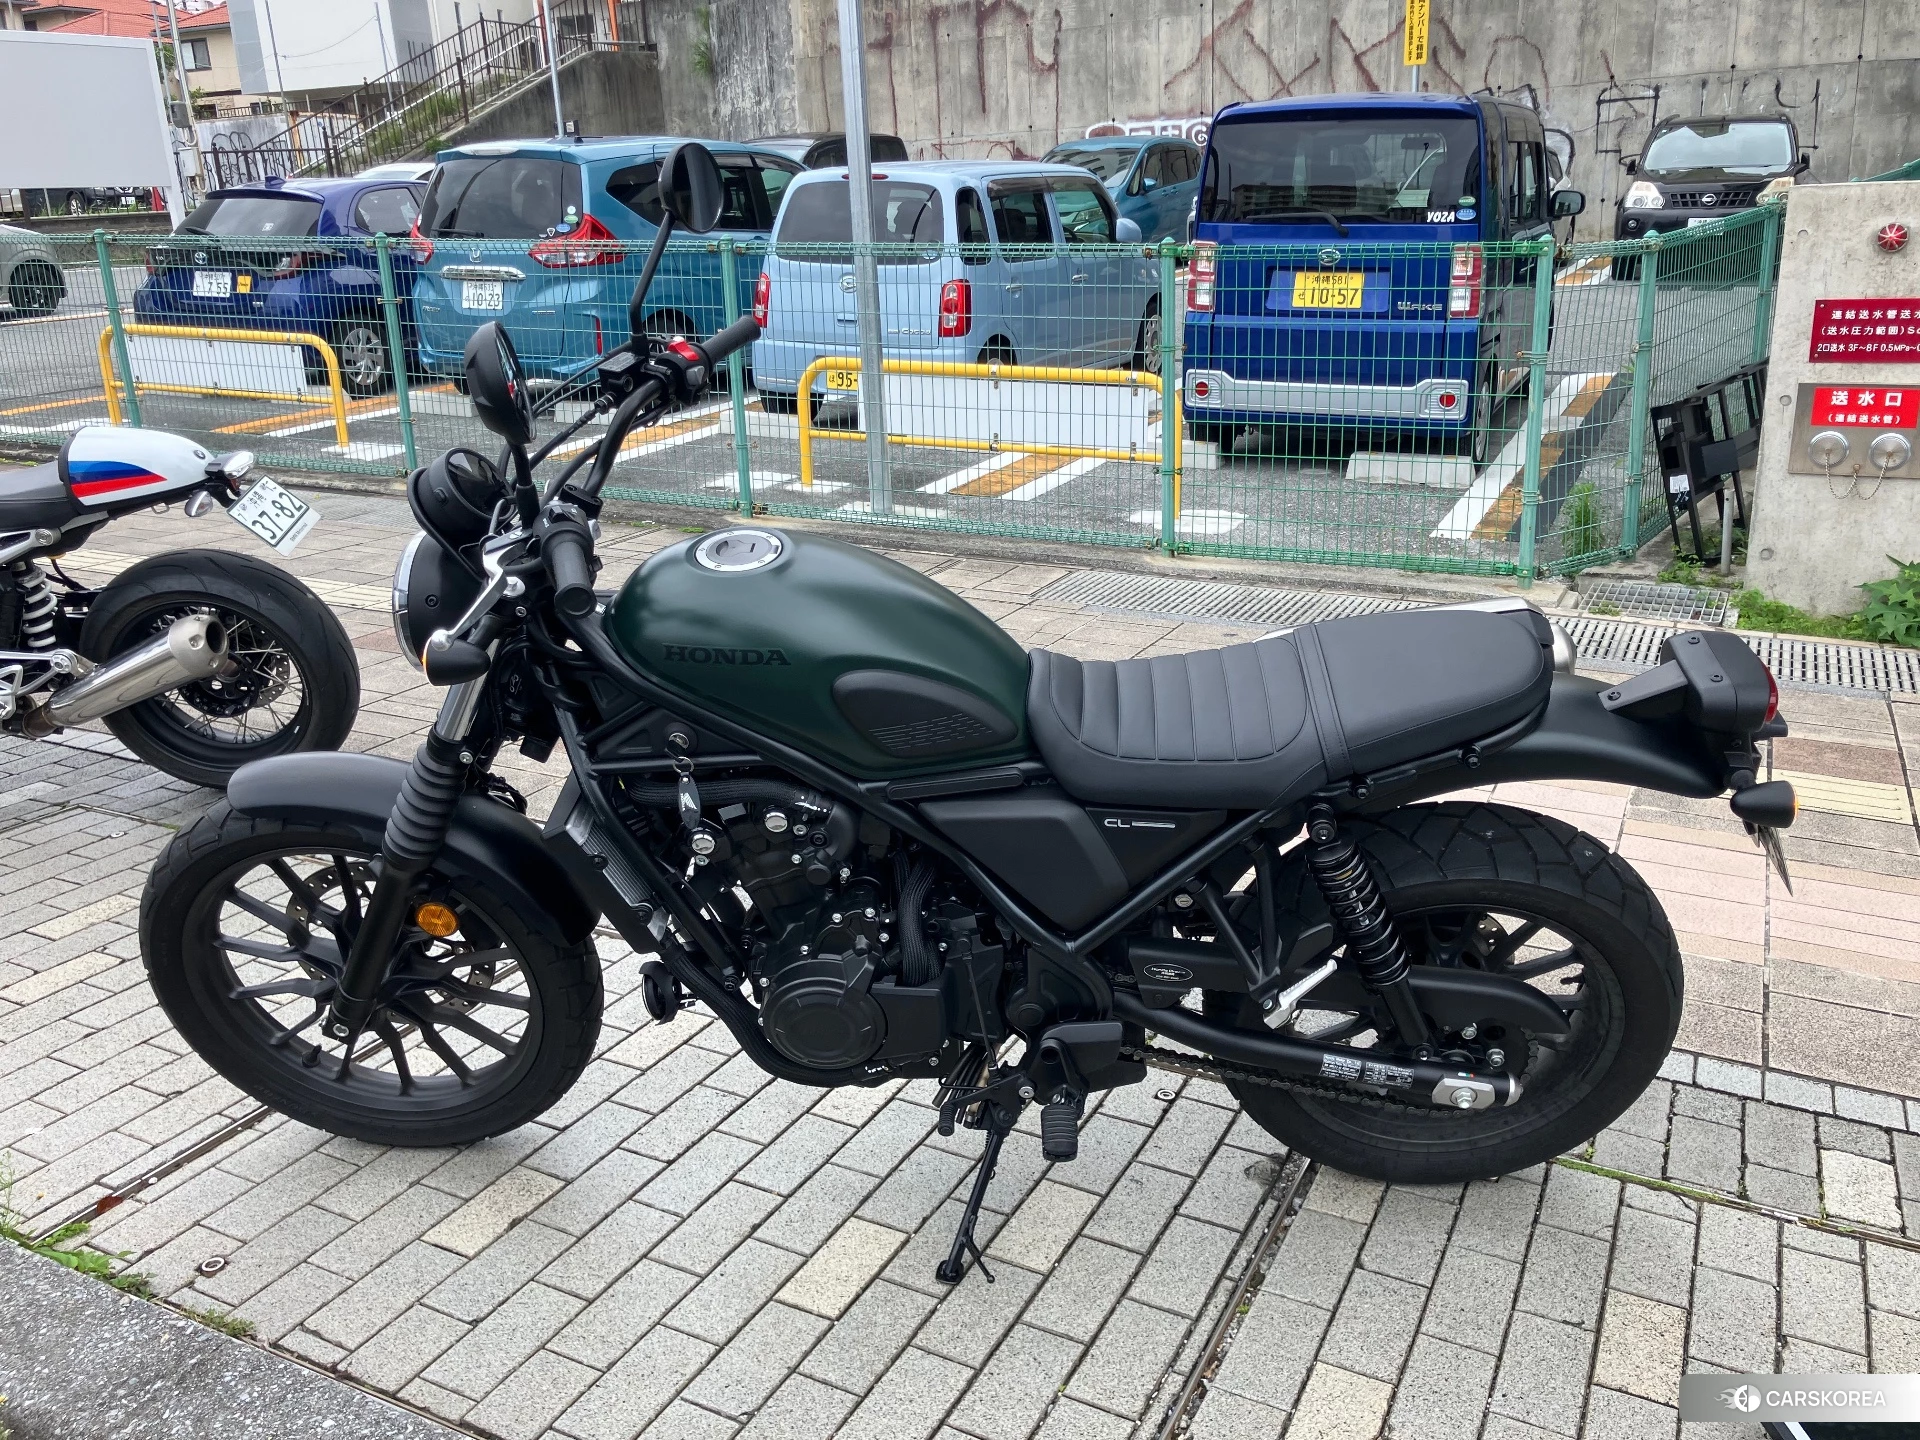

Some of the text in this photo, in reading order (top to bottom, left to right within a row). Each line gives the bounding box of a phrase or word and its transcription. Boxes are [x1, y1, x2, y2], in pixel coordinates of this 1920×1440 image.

[1426, 211, 1456, 223] YOZA
[471, 291, 501, 307] 10-23
[1309, 286, 1360, 306] 10-57
[1830, 390, 1903, 407] 送水口
[251, 491, 304, 541] 37-82
[662, 644, 792, 666] HONDA
